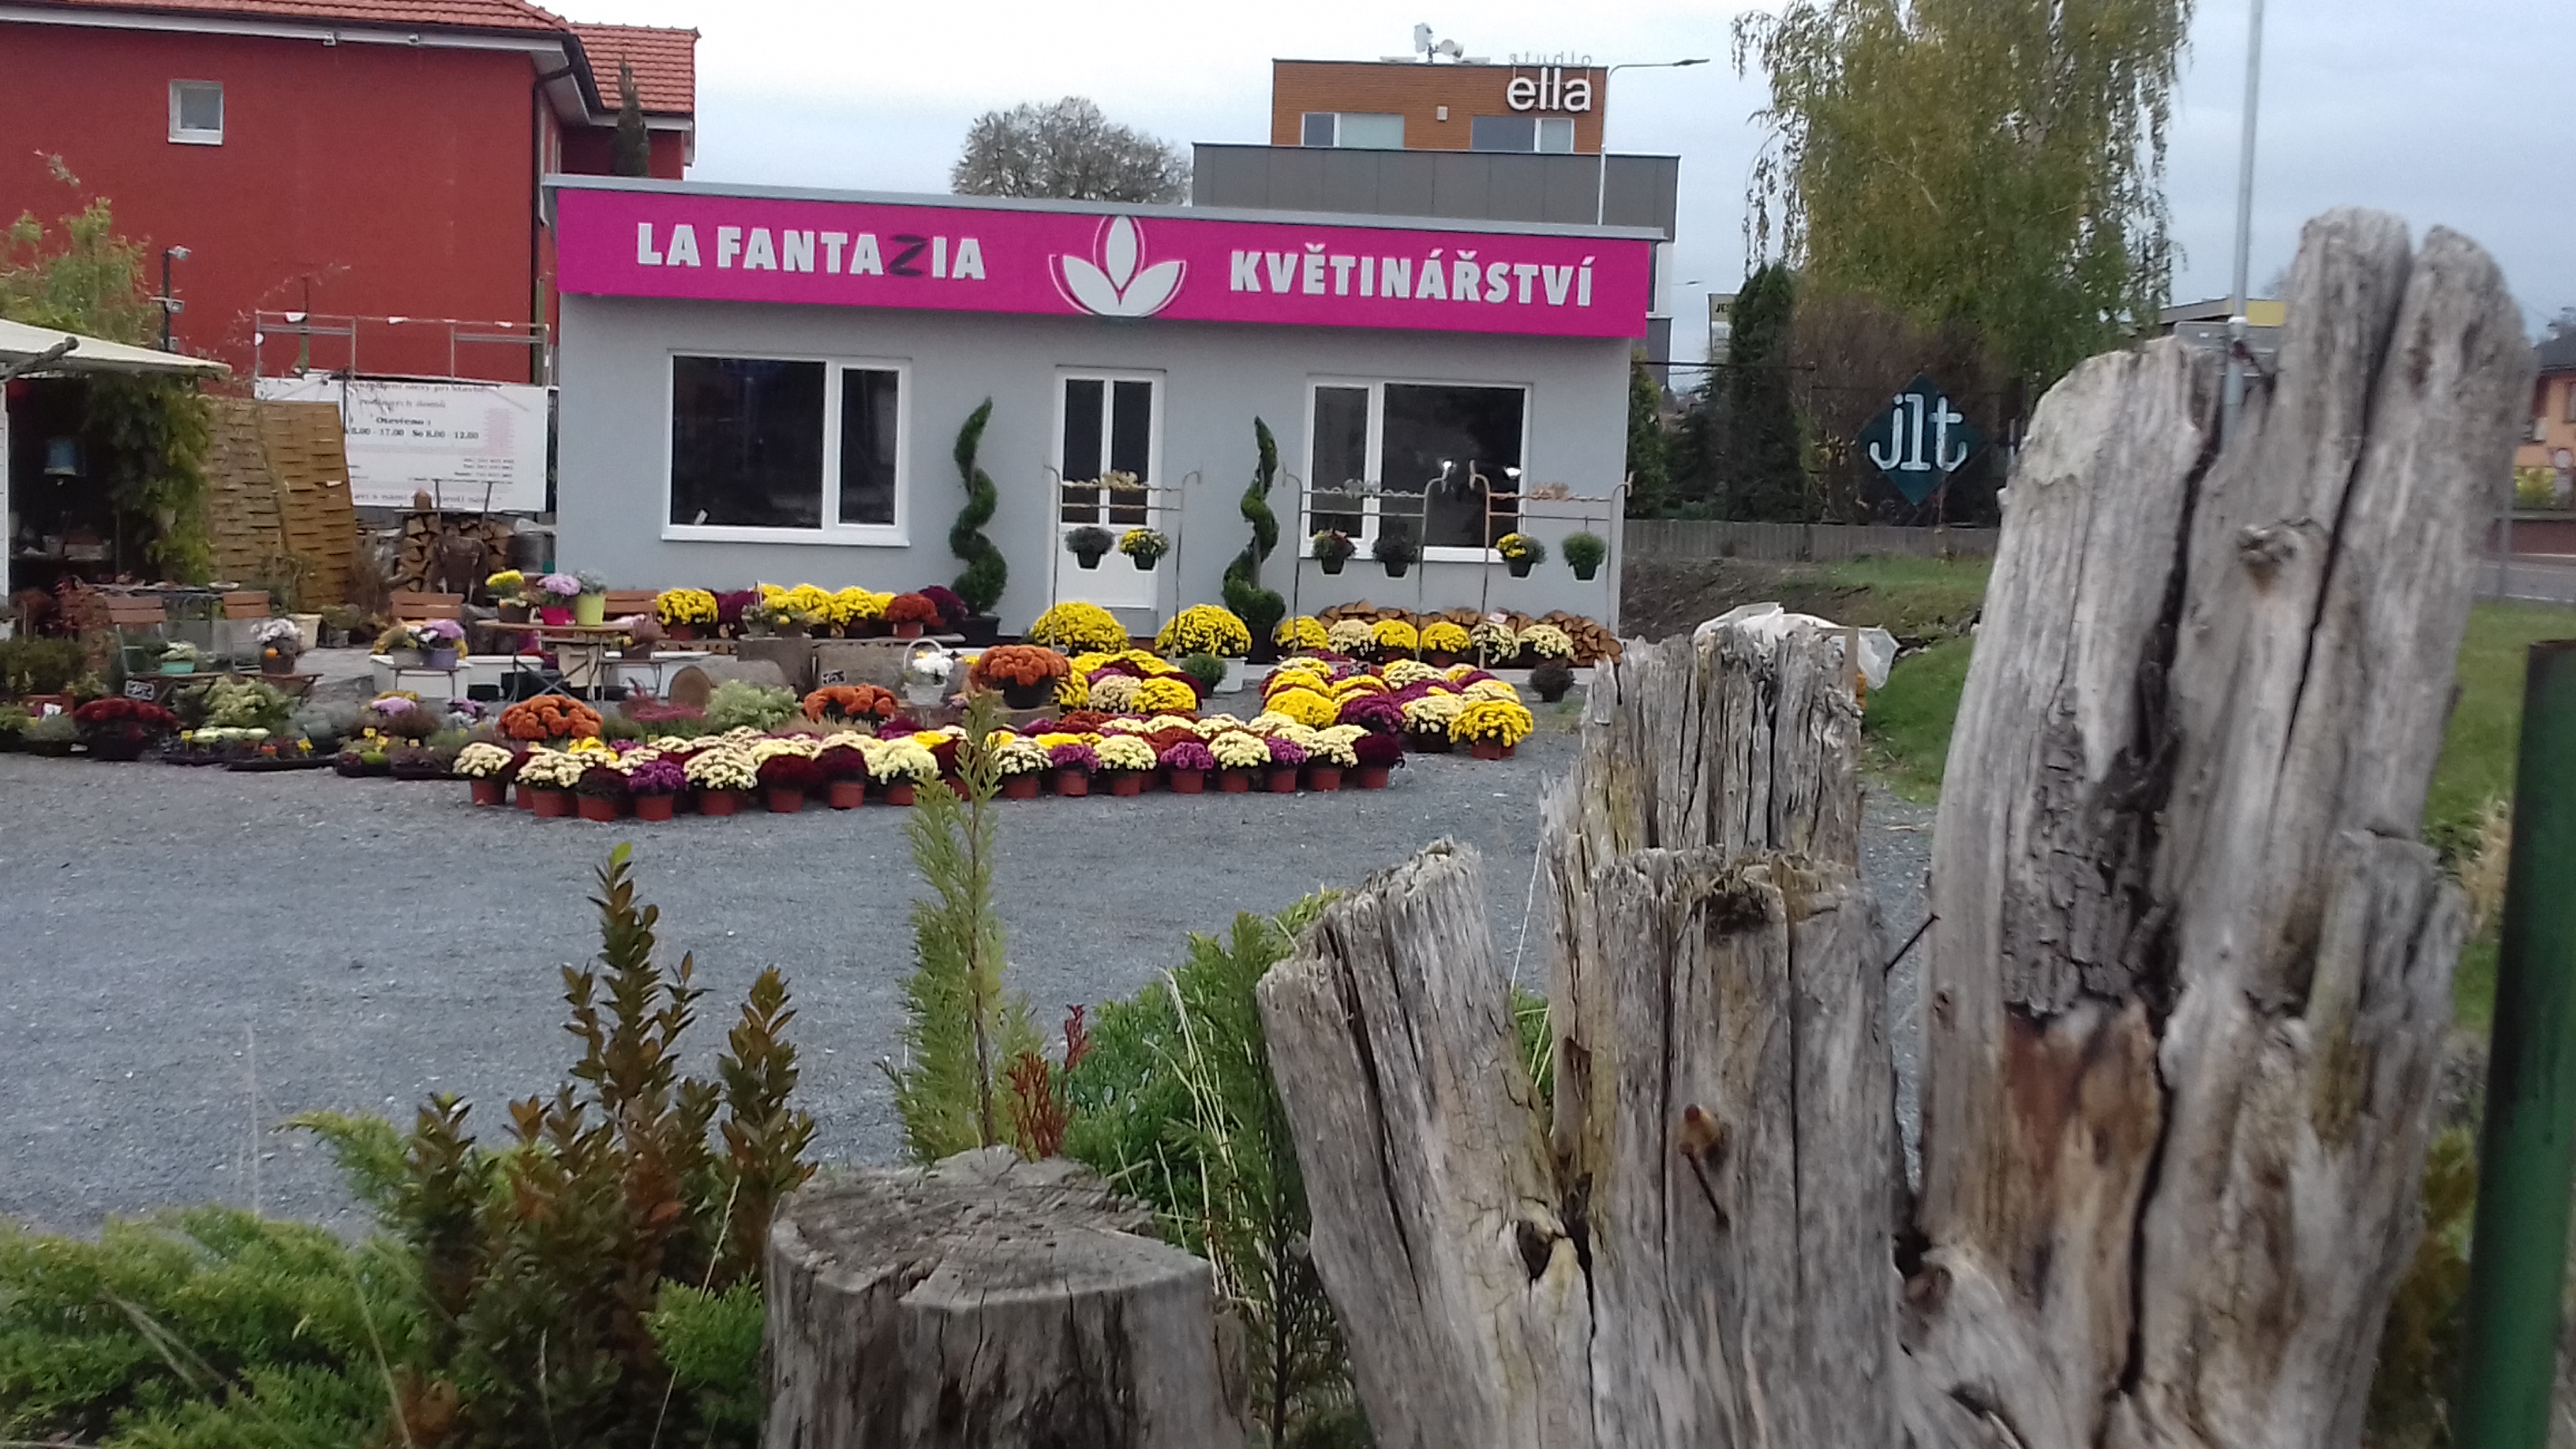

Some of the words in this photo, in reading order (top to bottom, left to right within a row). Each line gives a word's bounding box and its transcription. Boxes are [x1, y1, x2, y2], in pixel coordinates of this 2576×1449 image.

[1507, 66, 1592, 112] ella
[638, 222, 701, 268] LA
[717, 226, 987, 280] FANTAZIA
[1230, 242, 1597, 308] KVĚTINÁŘSTVÍ
